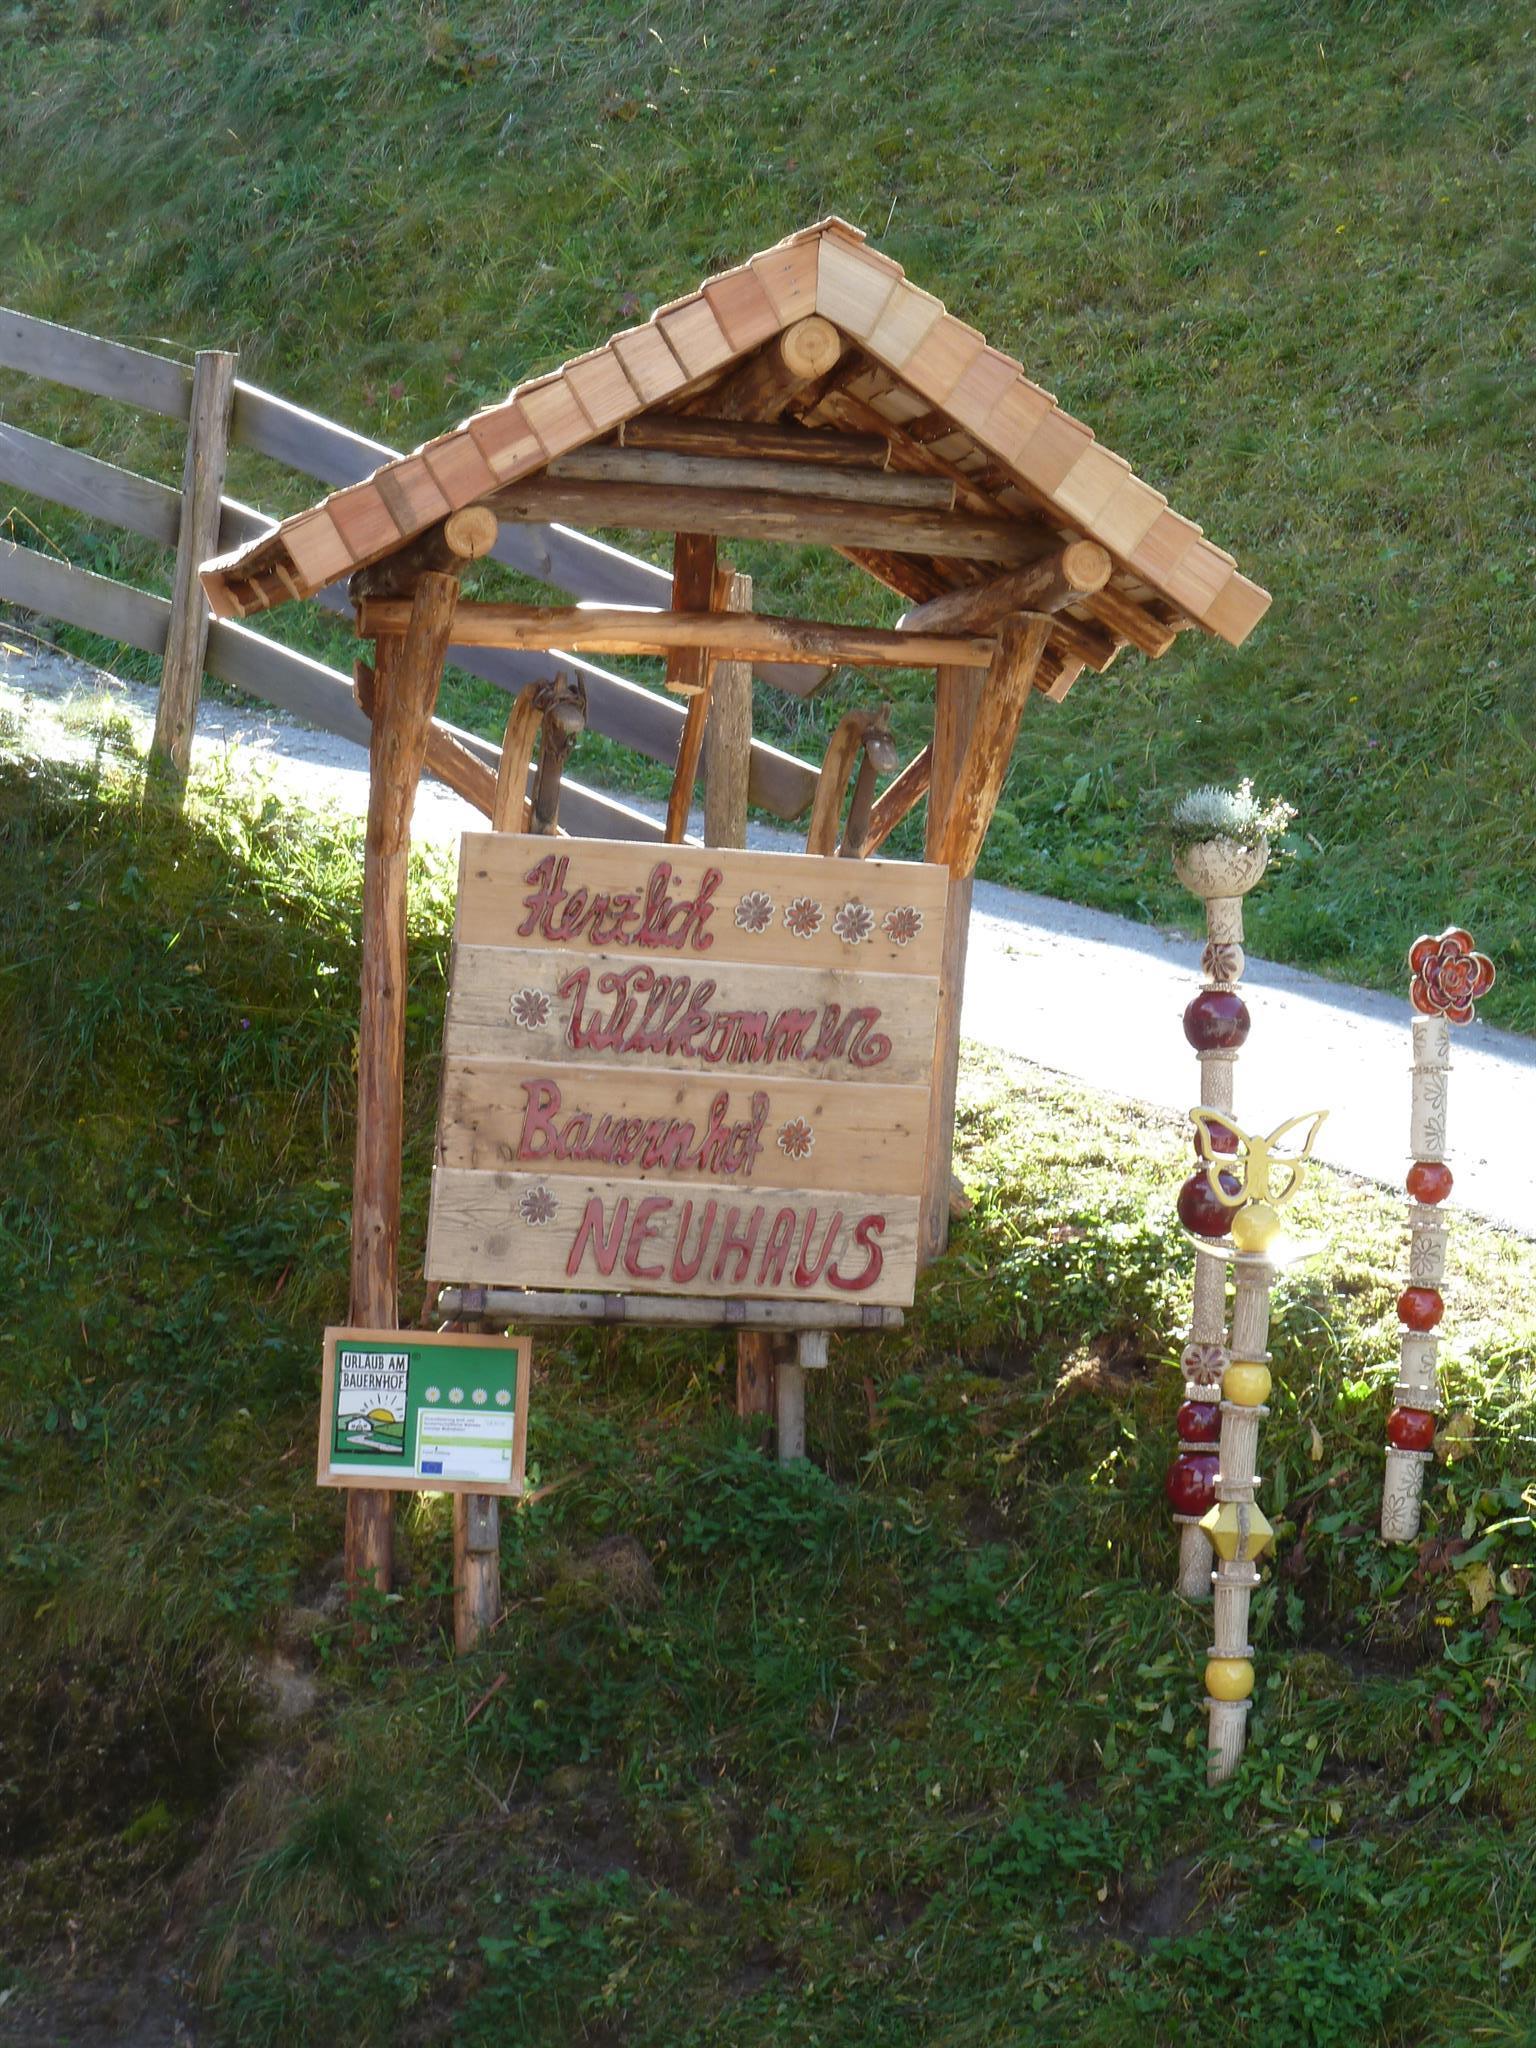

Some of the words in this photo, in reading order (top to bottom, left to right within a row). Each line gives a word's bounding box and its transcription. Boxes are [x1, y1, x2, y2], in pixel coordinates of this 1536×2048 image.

[517, 854, 723, 951] Herzlich
[557, 964, 892, 1067] Willkommen
[518, 1079, 770, 1175] Bauernhof
[566, 1197, 886, 1290] NEUHAUS
[343, 1373, 404, 1390] BAUERNHOF
[344, 1354, 384, 1371] URLAUB
[388, 1358, 405, 1371] AM
